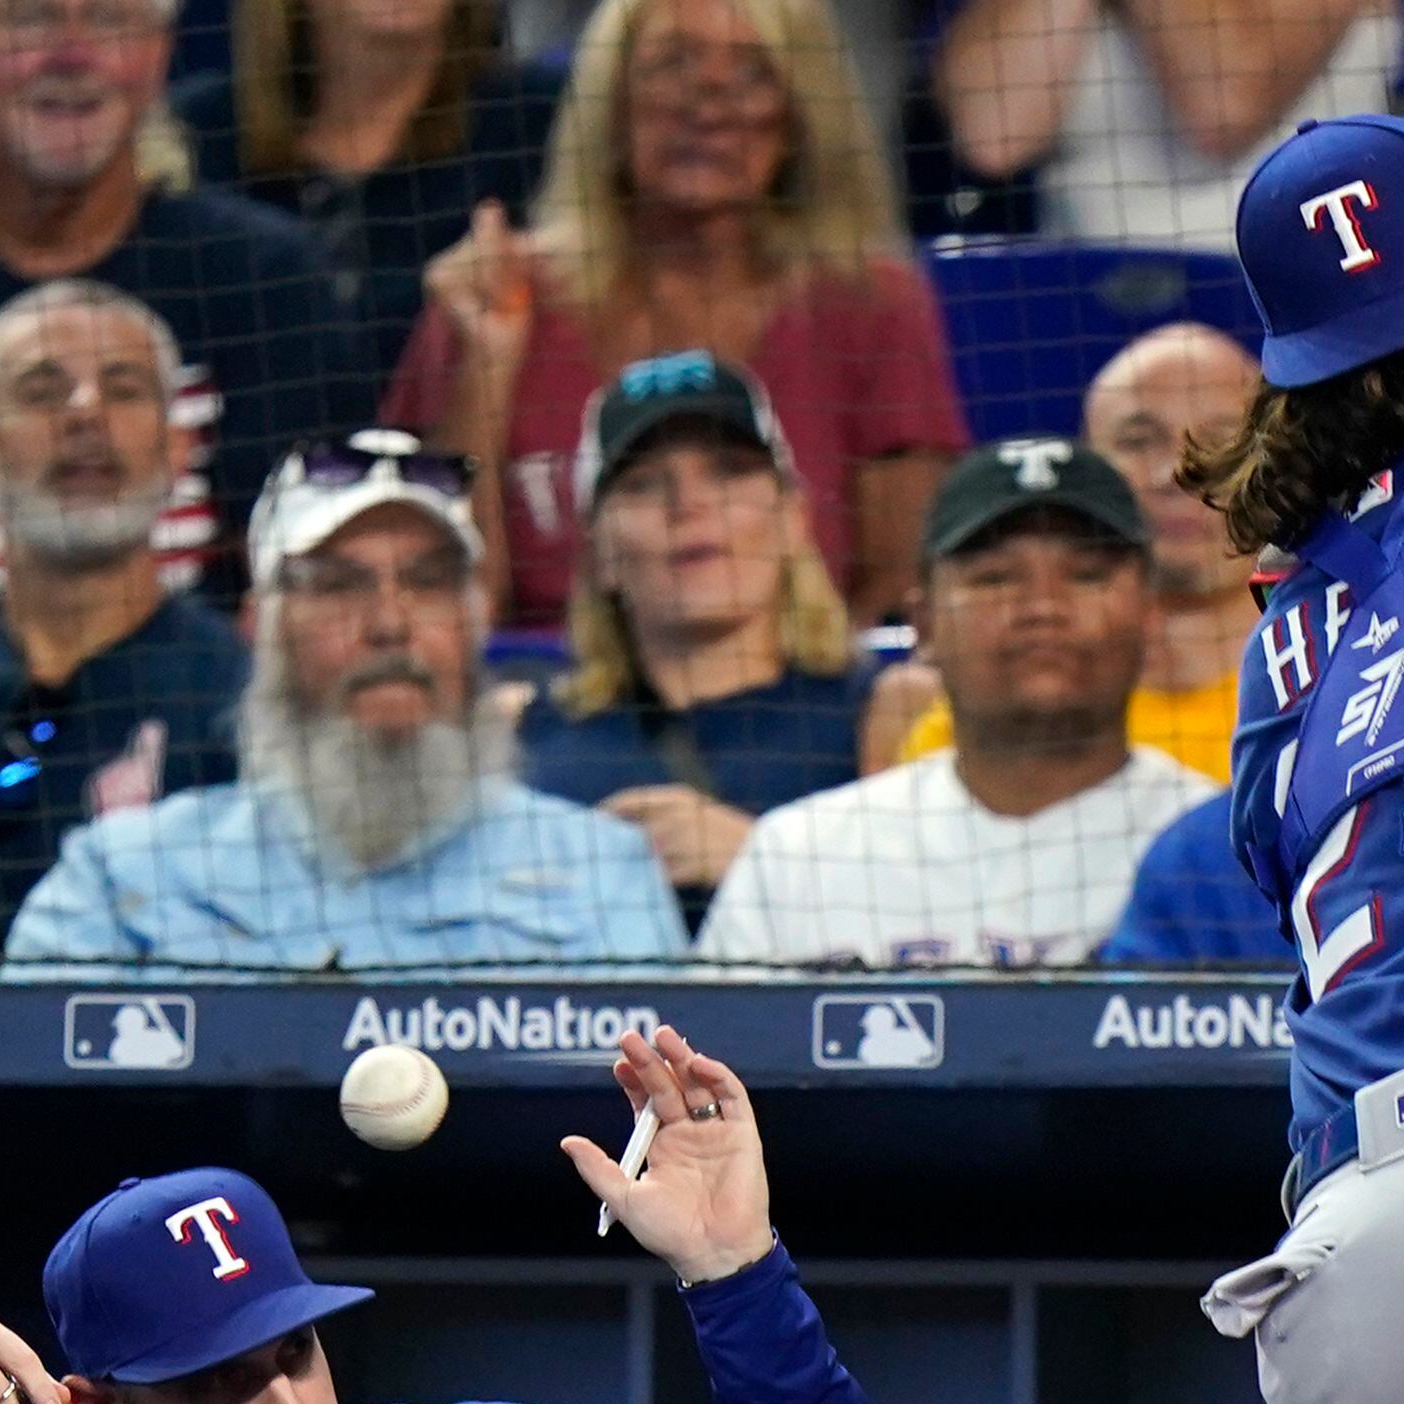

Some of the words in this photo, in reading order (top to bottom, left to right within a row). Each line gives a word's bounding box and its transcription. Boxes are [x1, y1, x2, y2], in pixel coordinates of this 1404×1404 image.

[1299, 179, 1381, 273] T
[997, 440, 1074, 489] T
[342, 996, 662, 1050] AutoNation
[165, 1197, 250, 1281] T
